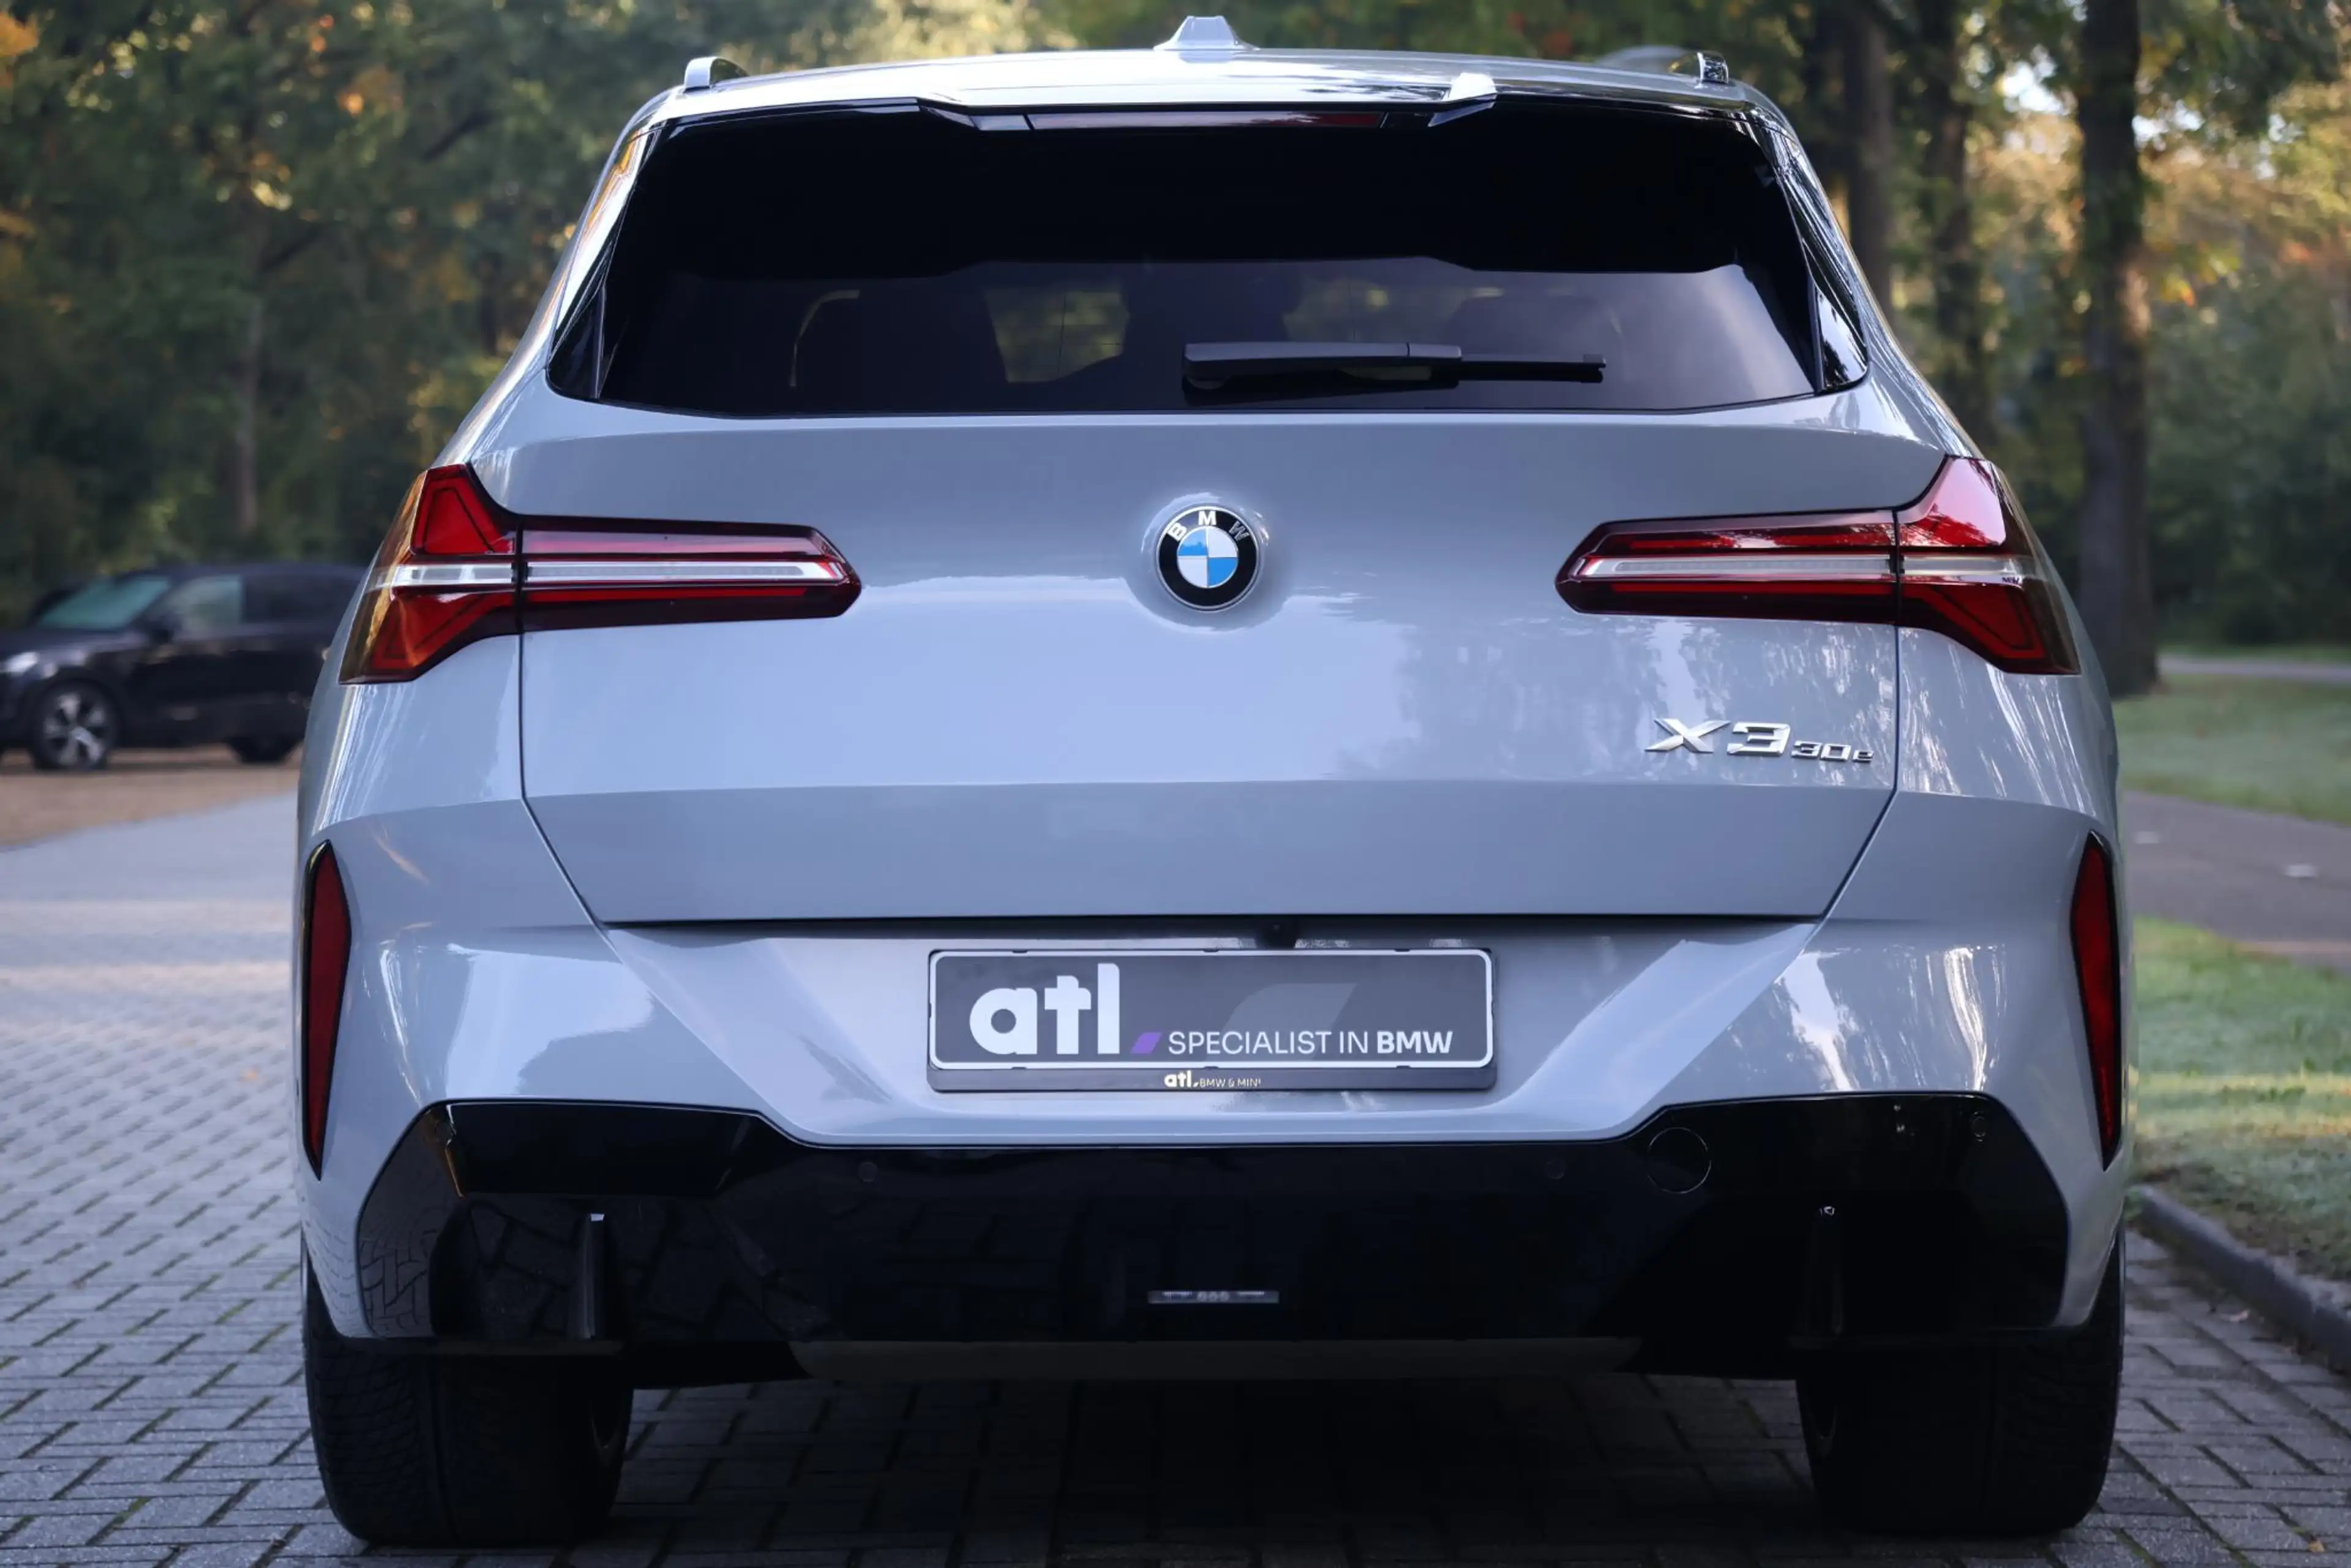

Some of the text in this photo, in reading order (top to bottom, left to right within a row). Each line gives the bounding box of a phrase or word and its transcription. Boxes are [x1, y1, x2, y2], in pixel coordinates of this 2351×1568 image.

[1167, 509, 1250, 542] BMW
[1644, 718, 1791, 755] X3
[970, 963, 1453, 1054] atl SPECIALIST IN BMW
[1164, 1070, 1192, 1087] atl
[1199, 1078, 1226, 1087] BMW
[1228, 1078, 1235, 1087] &
